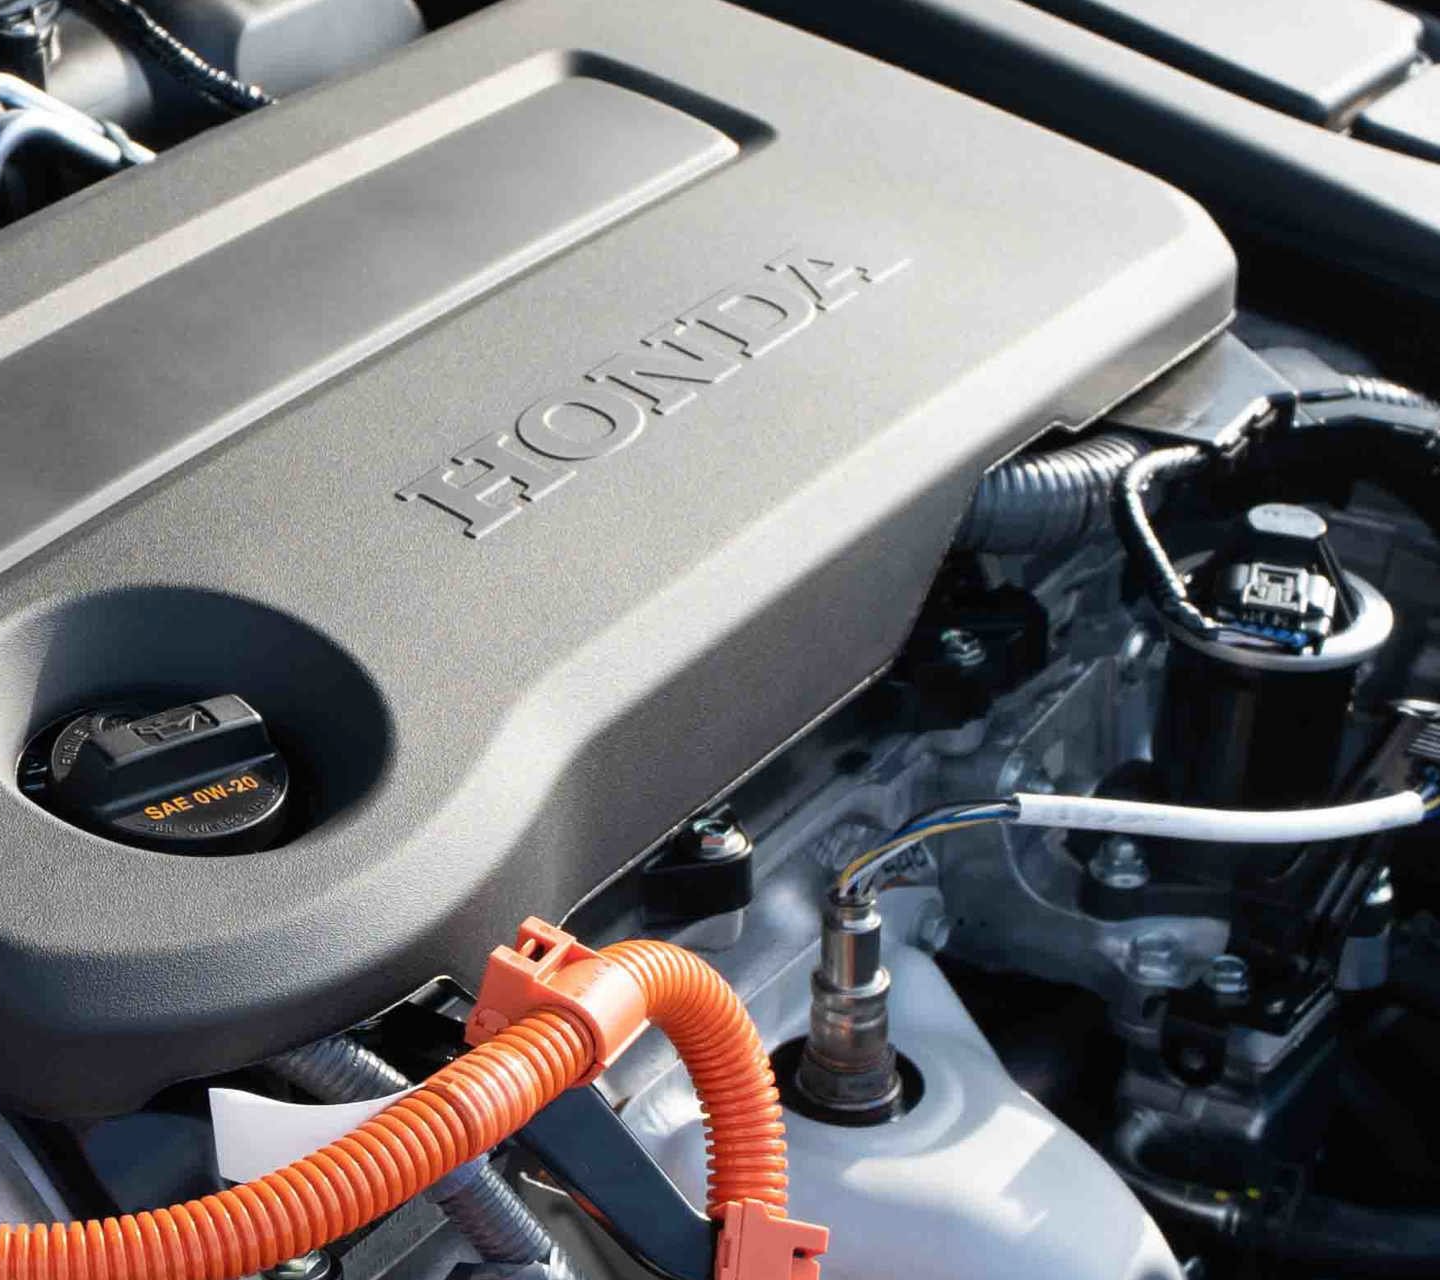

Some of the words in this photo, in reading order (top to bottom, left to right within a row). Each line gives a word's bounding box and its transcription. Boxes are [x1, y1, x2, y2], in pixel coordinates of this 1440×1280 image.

[394, 245, 913, 539] HONDA
[144, 795, 194, 821] SAE
[194, 774, 260, 805] 0W-20
